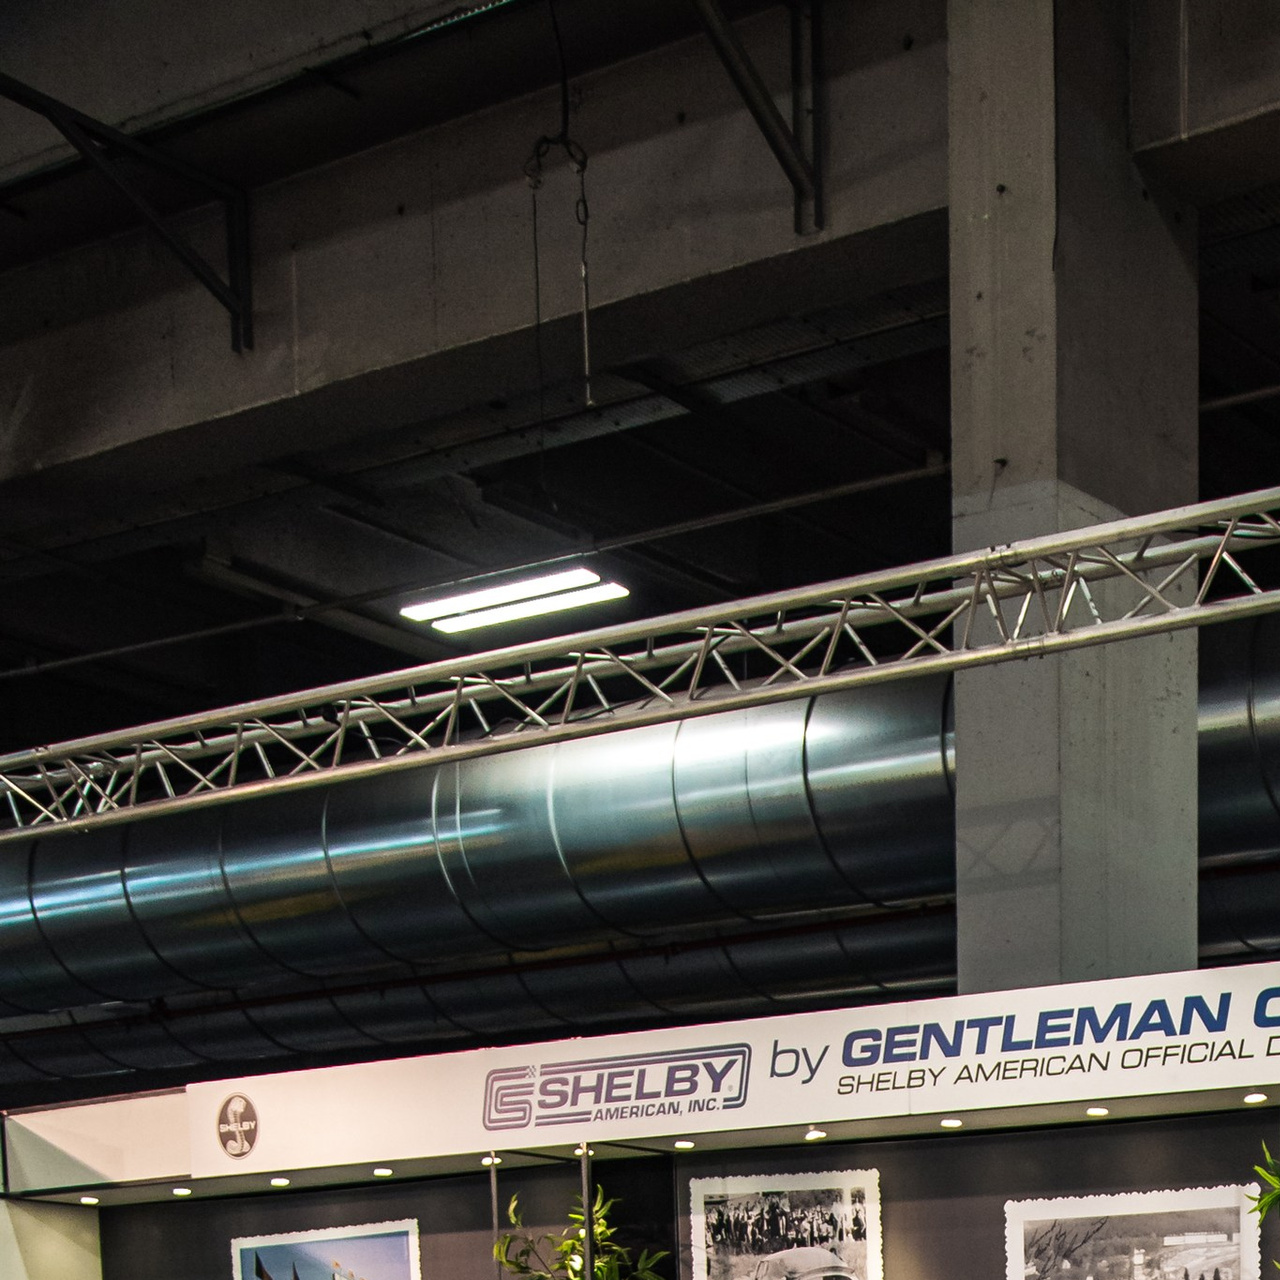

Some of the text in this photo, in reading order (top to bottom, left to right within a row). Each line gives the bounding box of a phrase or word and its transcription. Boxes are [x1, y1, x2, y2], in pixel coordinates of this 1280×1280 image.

[770, 1039, 830, 1084] by
[841, 991, 1232, 1068] GENTLEMAN
[537, 1058, 739, 1109] SHELBY
[837, 1066, 947, 1095] SHELBY
[954, 1051, 1110, 1085] AMERICAN
[1121, 1039, 1254, 1069] OFFICIAL
[220, 1121, 255, 1132] SHELBY
[593, 1098, 720, 1122] AMERICAN, INC.
